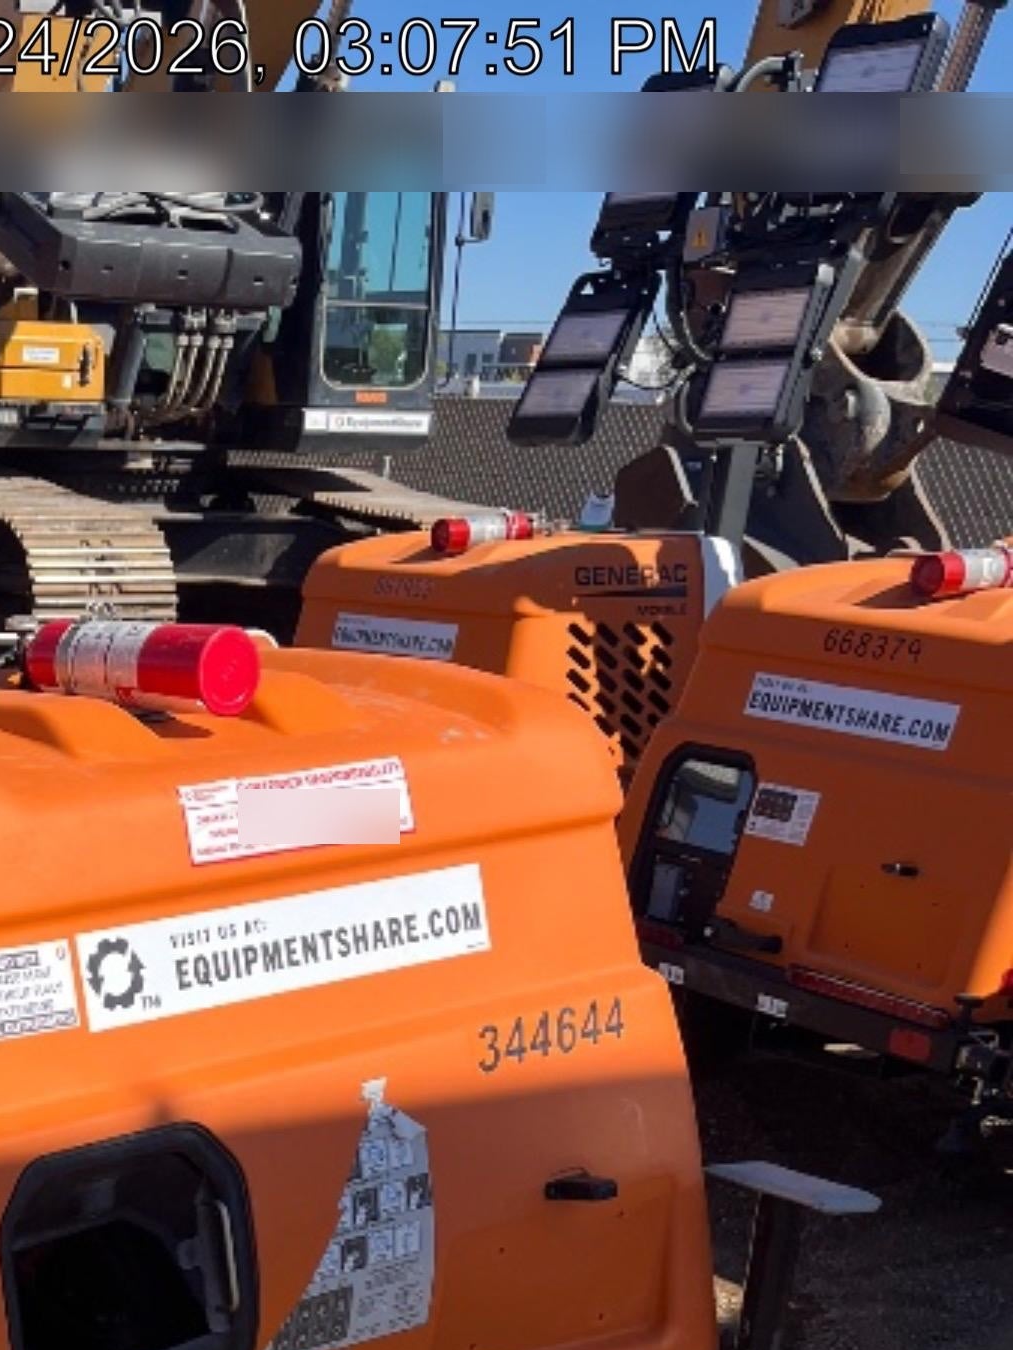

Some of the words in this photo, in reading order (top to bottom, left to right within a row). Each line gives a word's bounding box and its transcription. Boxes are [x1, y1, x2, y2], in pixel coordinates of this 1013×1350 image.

[575, 564, 687, 587] GENERAC
[824, 628, 922, 664] 668379
[748, 691, 952, 743] EQUIPMENTSHARE.COM
[170, 927, 211, 950] VISIT
[218, 924, 237, 939] US
[175, 901, 482, 991] EQUIPMENTSHARE.COM
[478, 996, 624, 1073] 344644
